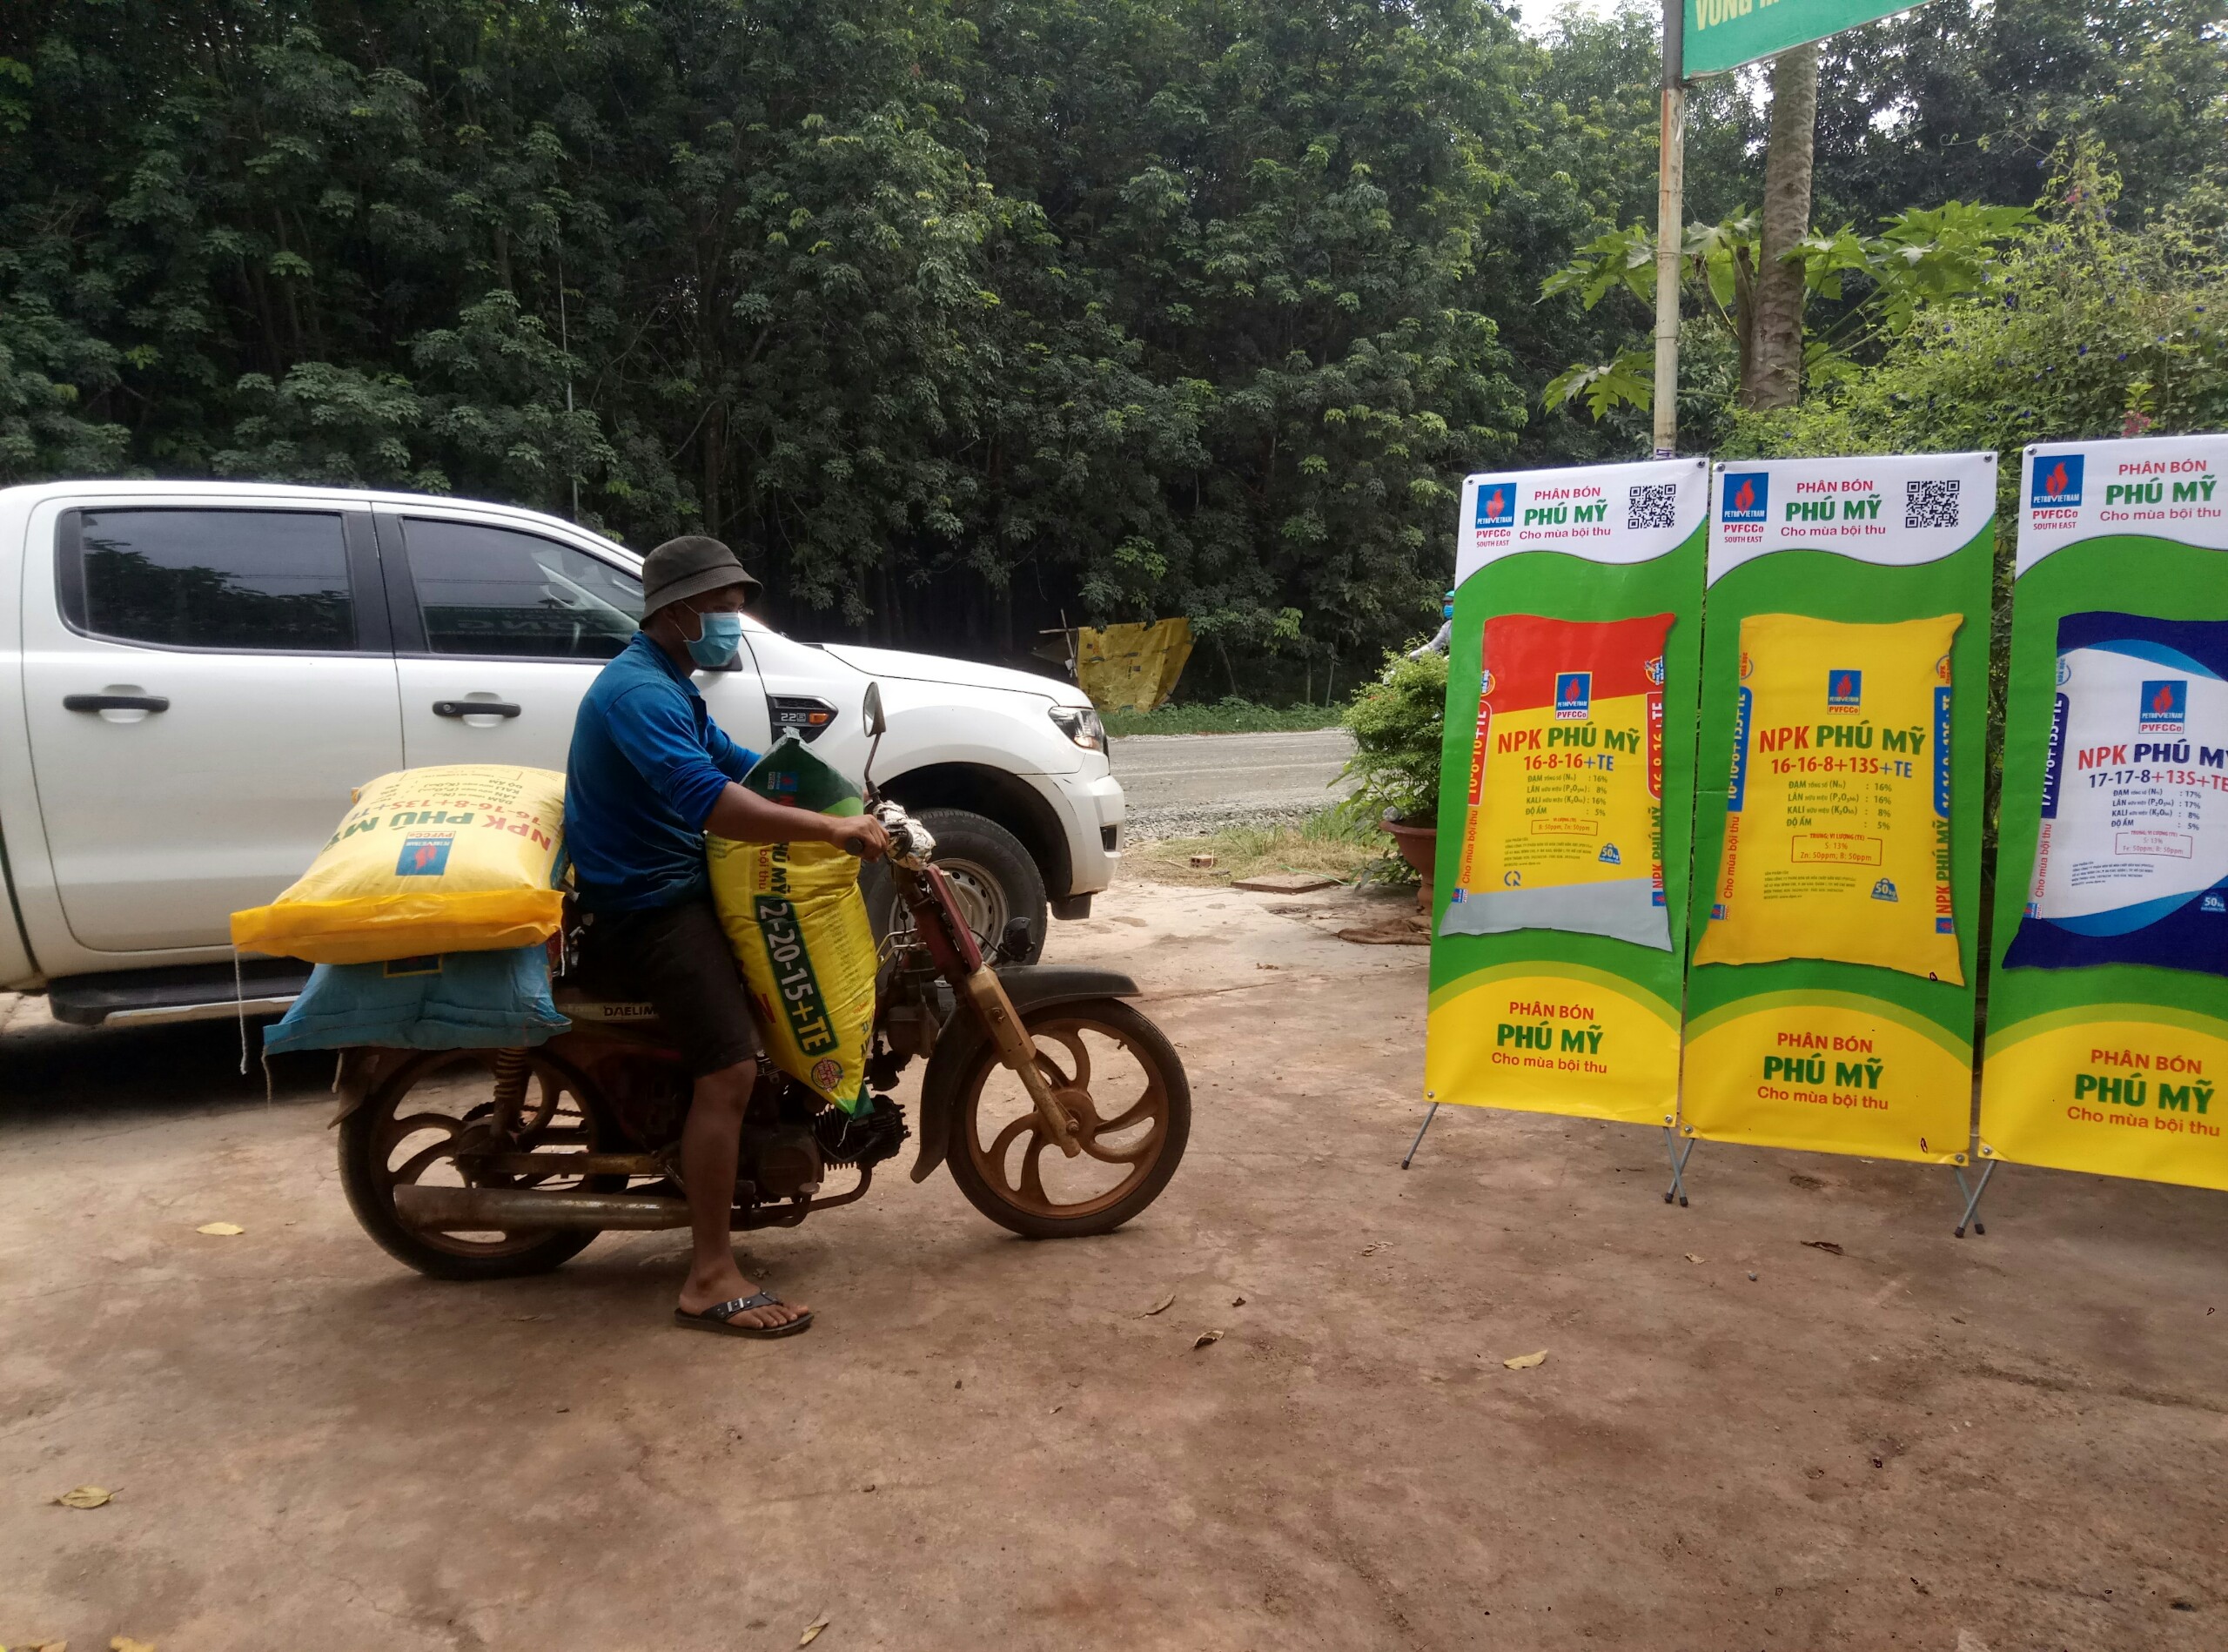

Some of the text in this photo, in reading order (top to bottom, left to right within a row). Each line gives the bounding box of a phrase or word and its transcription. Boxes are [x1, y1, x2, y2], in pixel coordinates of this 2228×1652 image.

[2118, 459, 2206, 475] PHÂN BÓN
[1534, 486, 1601, 500] PHÂN BÓN
[1796, 479, 1873, 494] PHÂN BÓN
[2106, 474, 2218, 505] PHÚ MỸ
[1786, 494, 1882, 521] PHÚ MỸ
[2033, 494, 2080, 503] PETROVIETNAM
[1525, 499, 1608, 526] PHÚ MỸ
[2033, 509, 2078, 519] PVFCCo
[2100, 507, 2221, 520] Cho mùa bội thu
[1476, 529, 1511, 538] PVFCCo
[1520, 527, 1611, 540] Cho mùa bội thu
[1723, 524, 1764, 534] PVFCCo
[1781, 525, 1886, 536] Cho mùa bội thu
[1498, 721, 1641, 755] NPK PHÚ MỸ
[1760, 720, 1925, 755] NPK PHÚ MỸ
[1524, 754, 1614, 771] 16-8-16+TE
[2078, 738, 2228, 770] NPK PHÚ M
[1772, 755, 1913, 778] 16-16-8+13S+TE
[1594, 775, 1608, 783] 16%
[1875, 783, 1892, 792] 16%
[1527, 785, 1540, 794] LÂN
[1788, 792, 1892, 805] LÂN 16%
[2186, 790, 2202, 799] 17%
[1593, 797, 1607, 806] 16%
[2184, 801, 2200, 809] 17%
[388, 811, 475, 830] PHÚ
[1525, 807, 1535, 816] ĐỘ
[1878, 809, 1890, 818] 8%
[1728, 816, 1739, 834] thu
[1786, 817, 1890, 830] ĐỘ 5%
[1932, 820, 1950, 844] MỸ
[2111, 819, 2122, 829] ĐỘ
[482, 815, 552, 851] NPK
[1466, 826, 1478, 841] bội
[1728, 836, 1739, 851] bội
[2164, 846, 2183, 855] 50ppm
[1464, 843, 1474, 863] mùa
[1849, 853, 1871, 862] 50ppm
[2035, 878, 2045, 897] Cho
[2042, 823, 2051, 838] thu
[757, 850, 769, 890] bội thu
[1725, 854, 1736, 876] mùa
[771, 868, 791, 895] MỸ
[1462, 865, 1473, 884] Cho
[1723, 878, 1734, 898] Cho
[1936, 884, 1951, 914] NPK
[1509, 1001, 1594, 1020] PHÂN BÓN
[1497, 1020, 1603, 1055] PHÚ MỸ
[1777, 1032, 1873, 1053] PHÂN BÓN
[1492, 1051, 1607, 1074] Cho mùa bội thu
[2090, 1050, 2202, 1074] PHÂN BÓN
[1763, 1053, 1883, 1090] PHÚ MỸ
[1758, 1086, 1889, 1110] Cho mùa bội thu
[2075, 1072, 2214, 1114] PHÚ MỸ
[2067, 1106, 2220, 1137] Cho mùa bội thu
